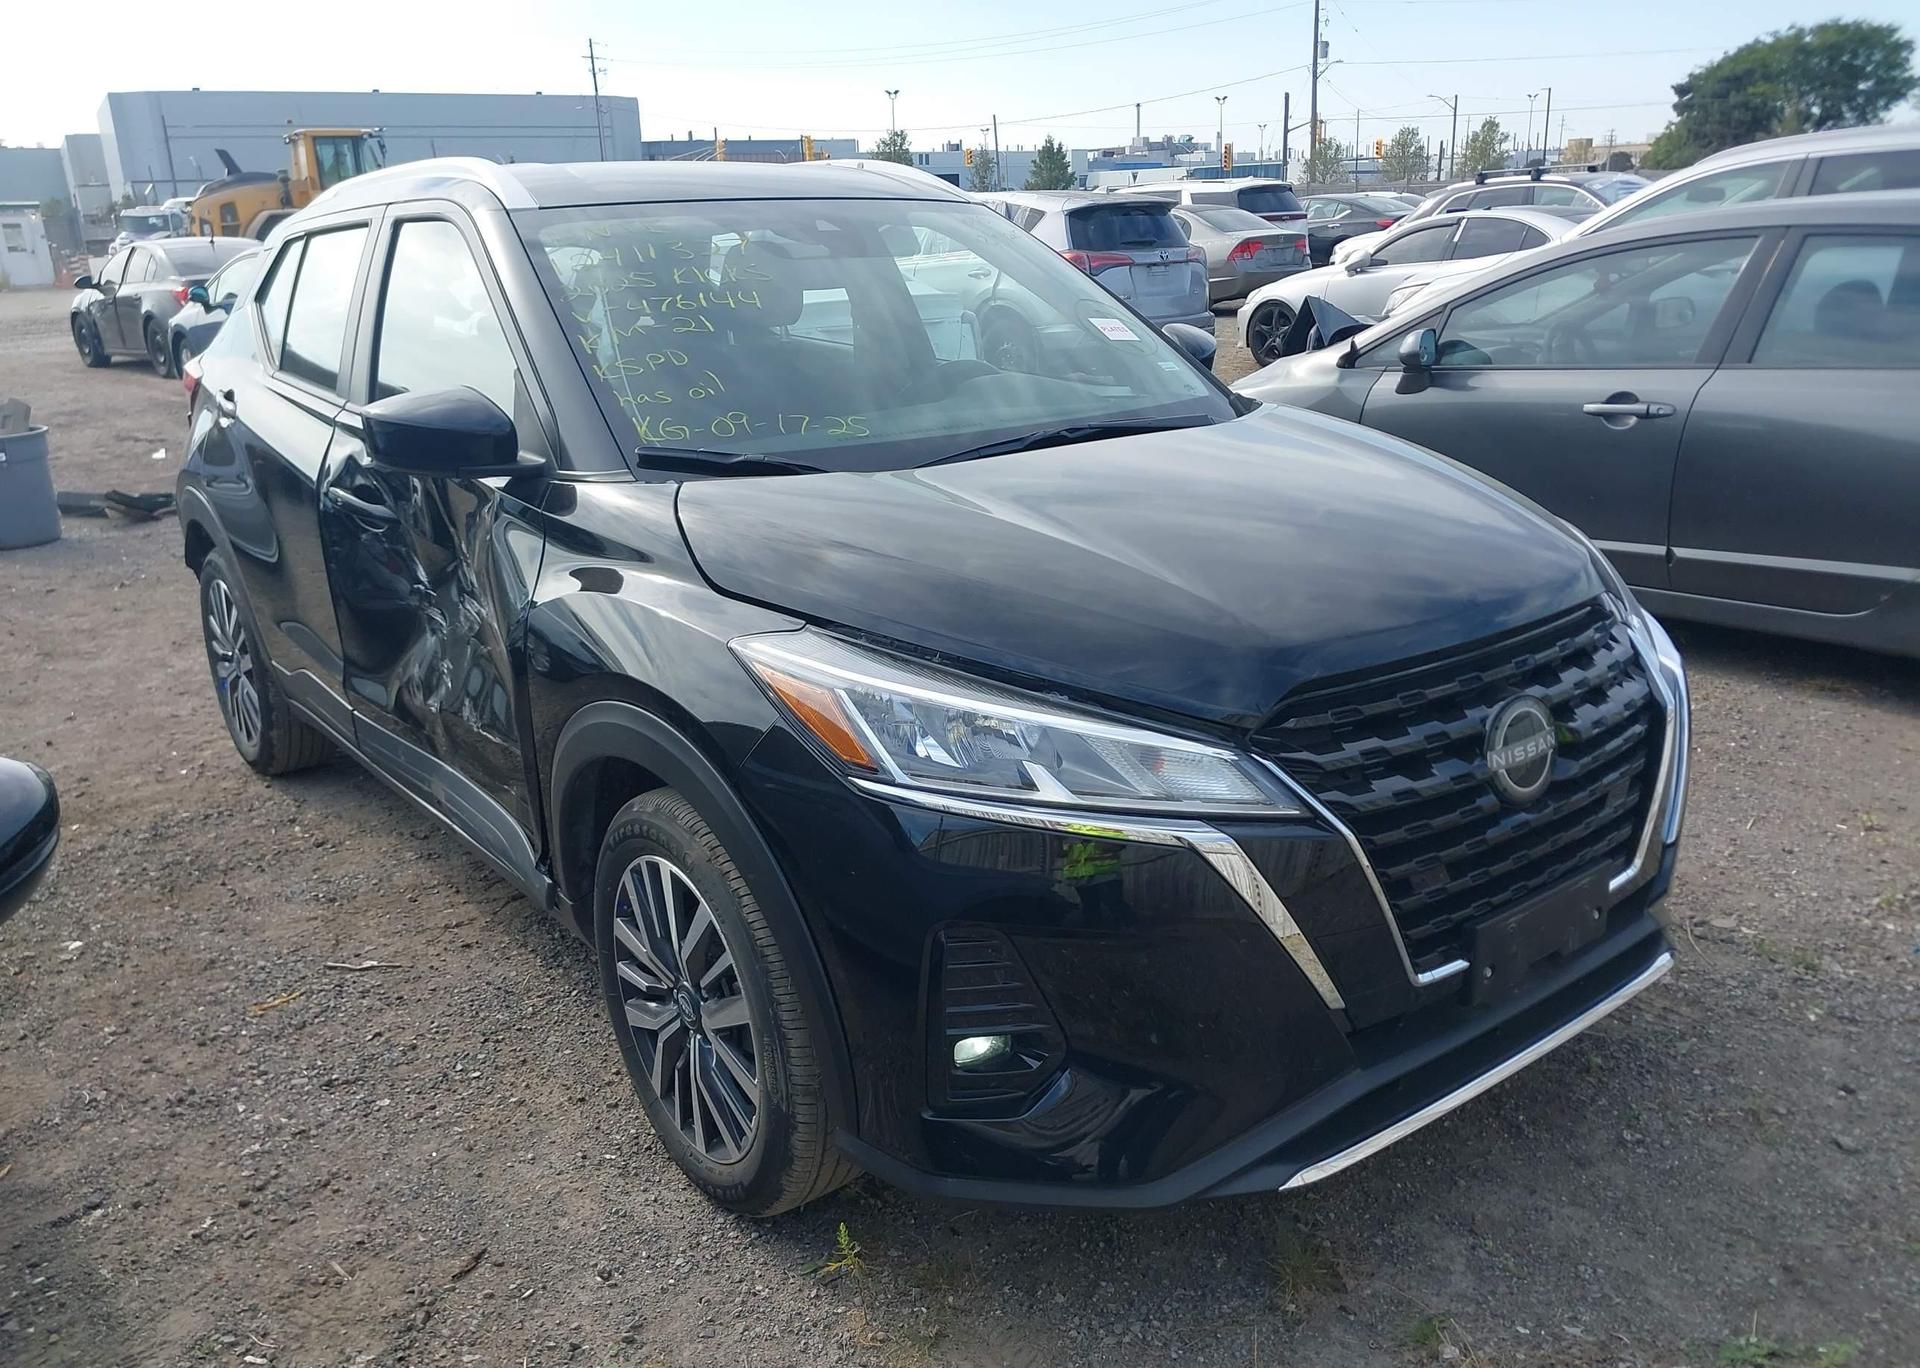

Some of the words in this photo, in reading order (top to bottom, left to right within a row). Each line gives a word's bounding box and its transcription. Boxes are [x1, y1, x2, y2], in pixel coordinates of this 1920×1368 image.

[613, 390, 673, 407] has
[689, 369, 726, 399] oil
[1492, 731, 1556, 768] NISSAN
